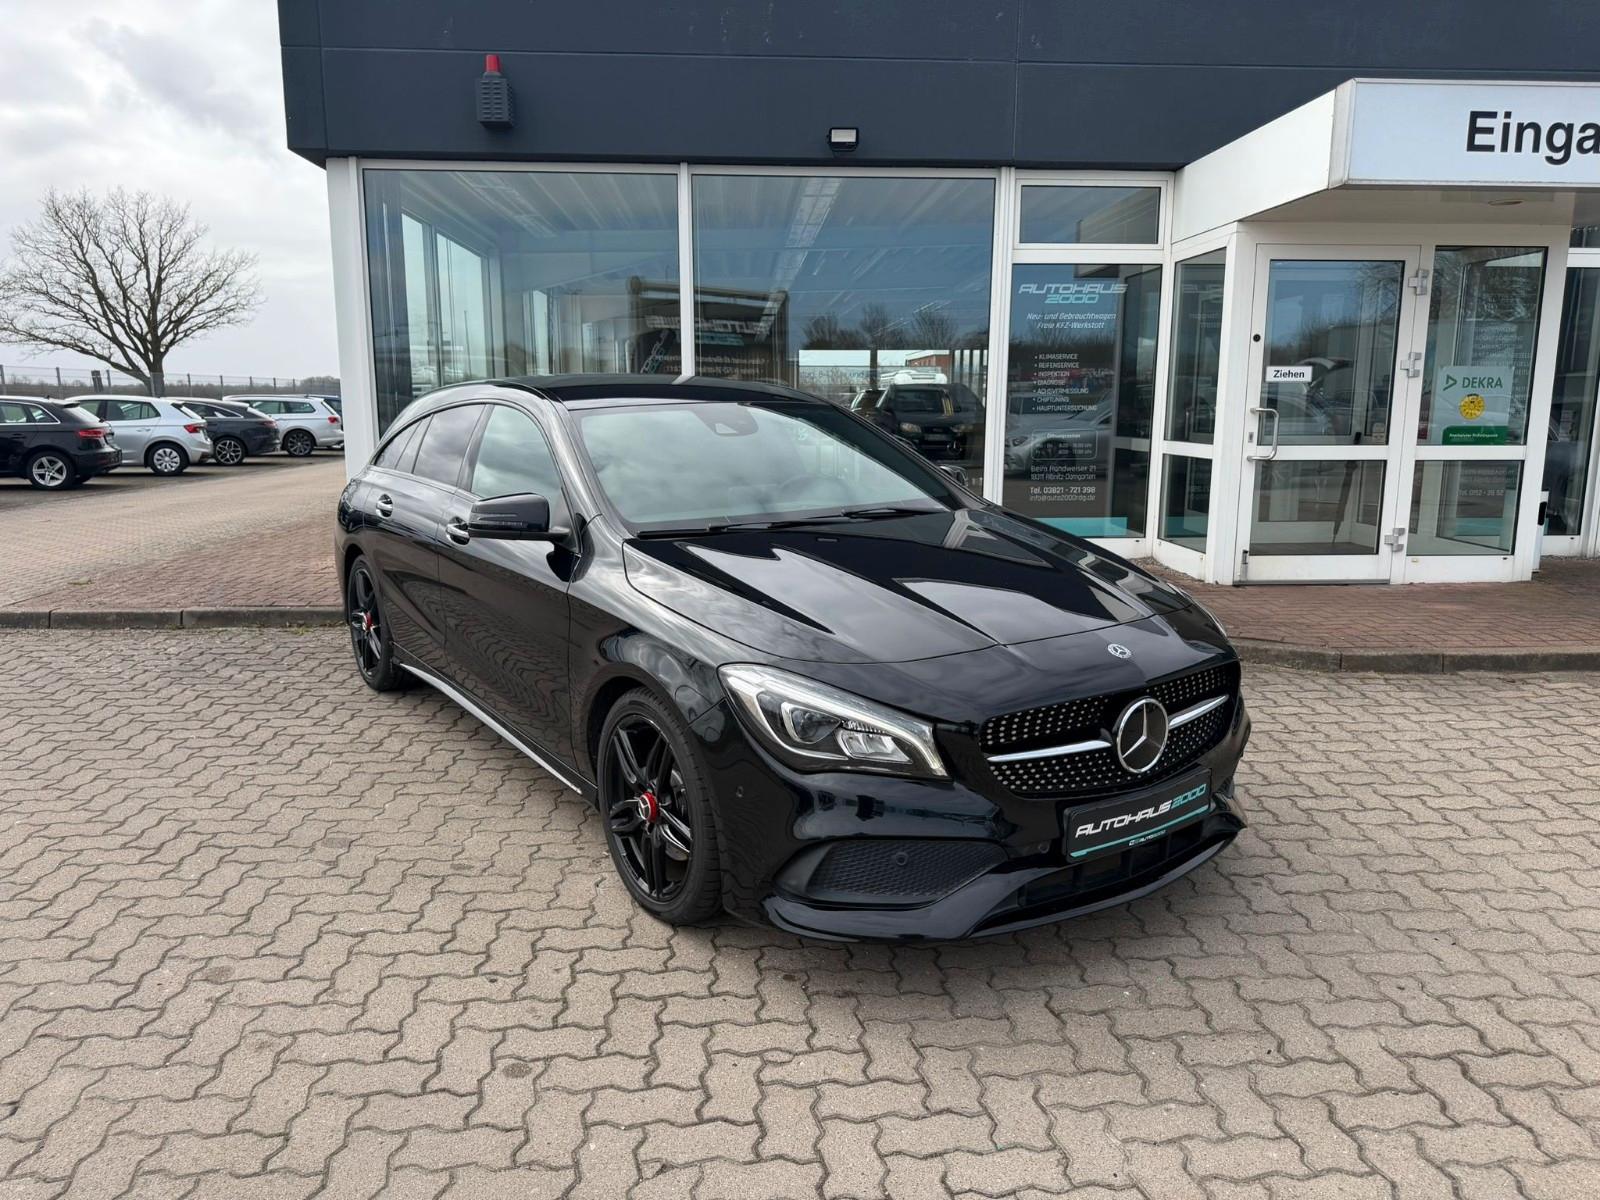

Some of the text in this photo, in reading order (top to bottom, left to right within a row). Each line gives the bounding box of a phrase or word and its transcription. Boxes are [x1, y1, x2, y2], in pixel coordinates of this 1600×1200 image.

[1466, 110, 1600, 166] Einga
[1018, 283, 1129, 294] AUTOHAUS
[1044, 294, 1100, 304] 2000
[1044, 312, 1058, 320] und
[1273, 369, 1305, 379] Ziehen
[1462, 376, 1504, 389] DEKRA
[1030, 486, 1042, 494] Tel.
